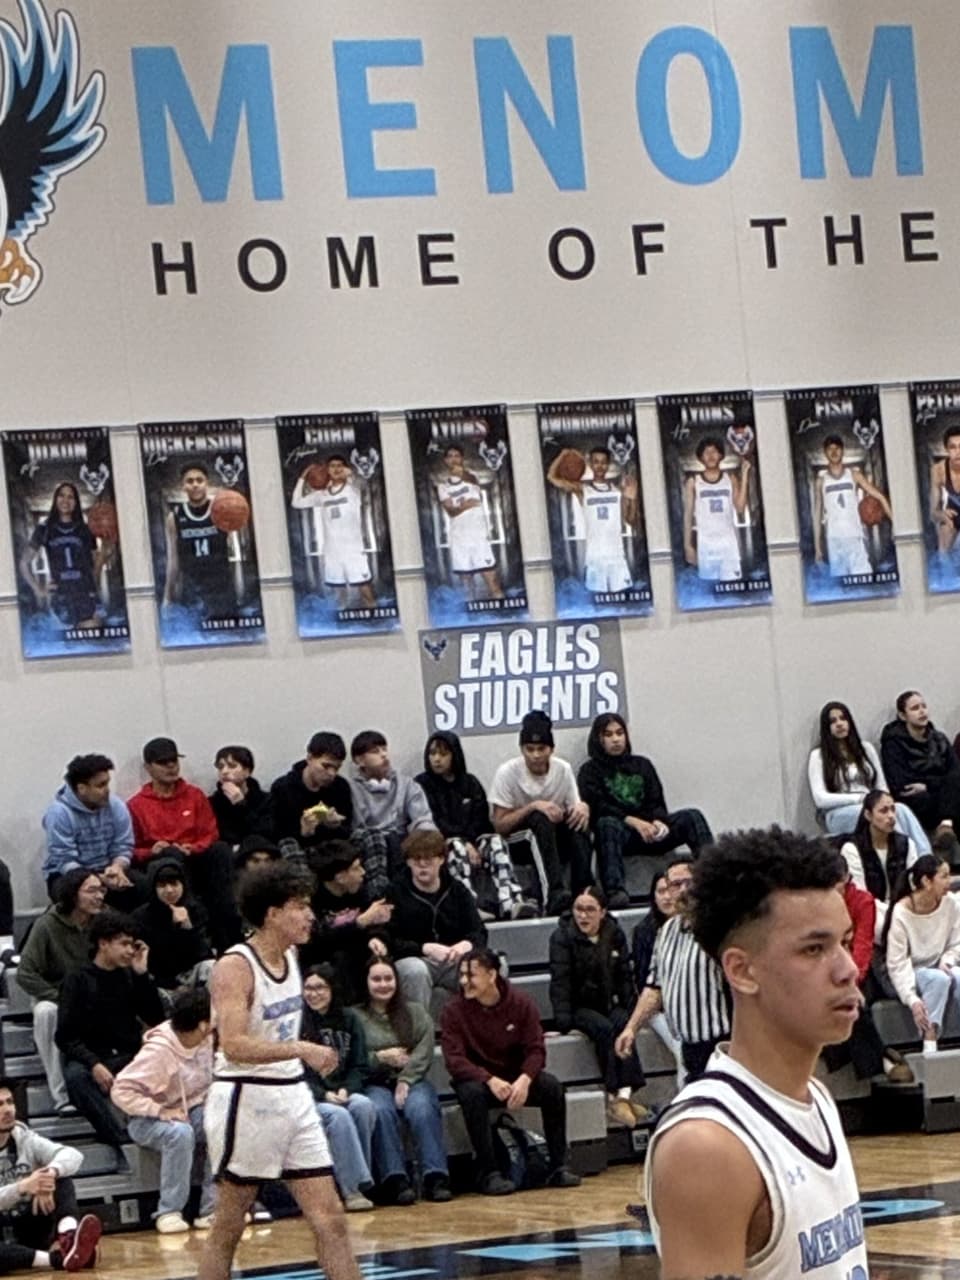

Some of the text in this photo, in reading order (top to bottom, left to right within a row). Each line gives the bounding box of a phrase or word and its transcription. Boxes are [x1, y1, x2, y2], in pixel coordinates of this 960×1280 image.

[151, 233, 460, 295] HOME
[548, 223, 666, 281] OF
[750, 211, 939, 269] THE
[459, 624, 601, 679] EAGLES
[434, 671, 619, 731] STUDENTS
